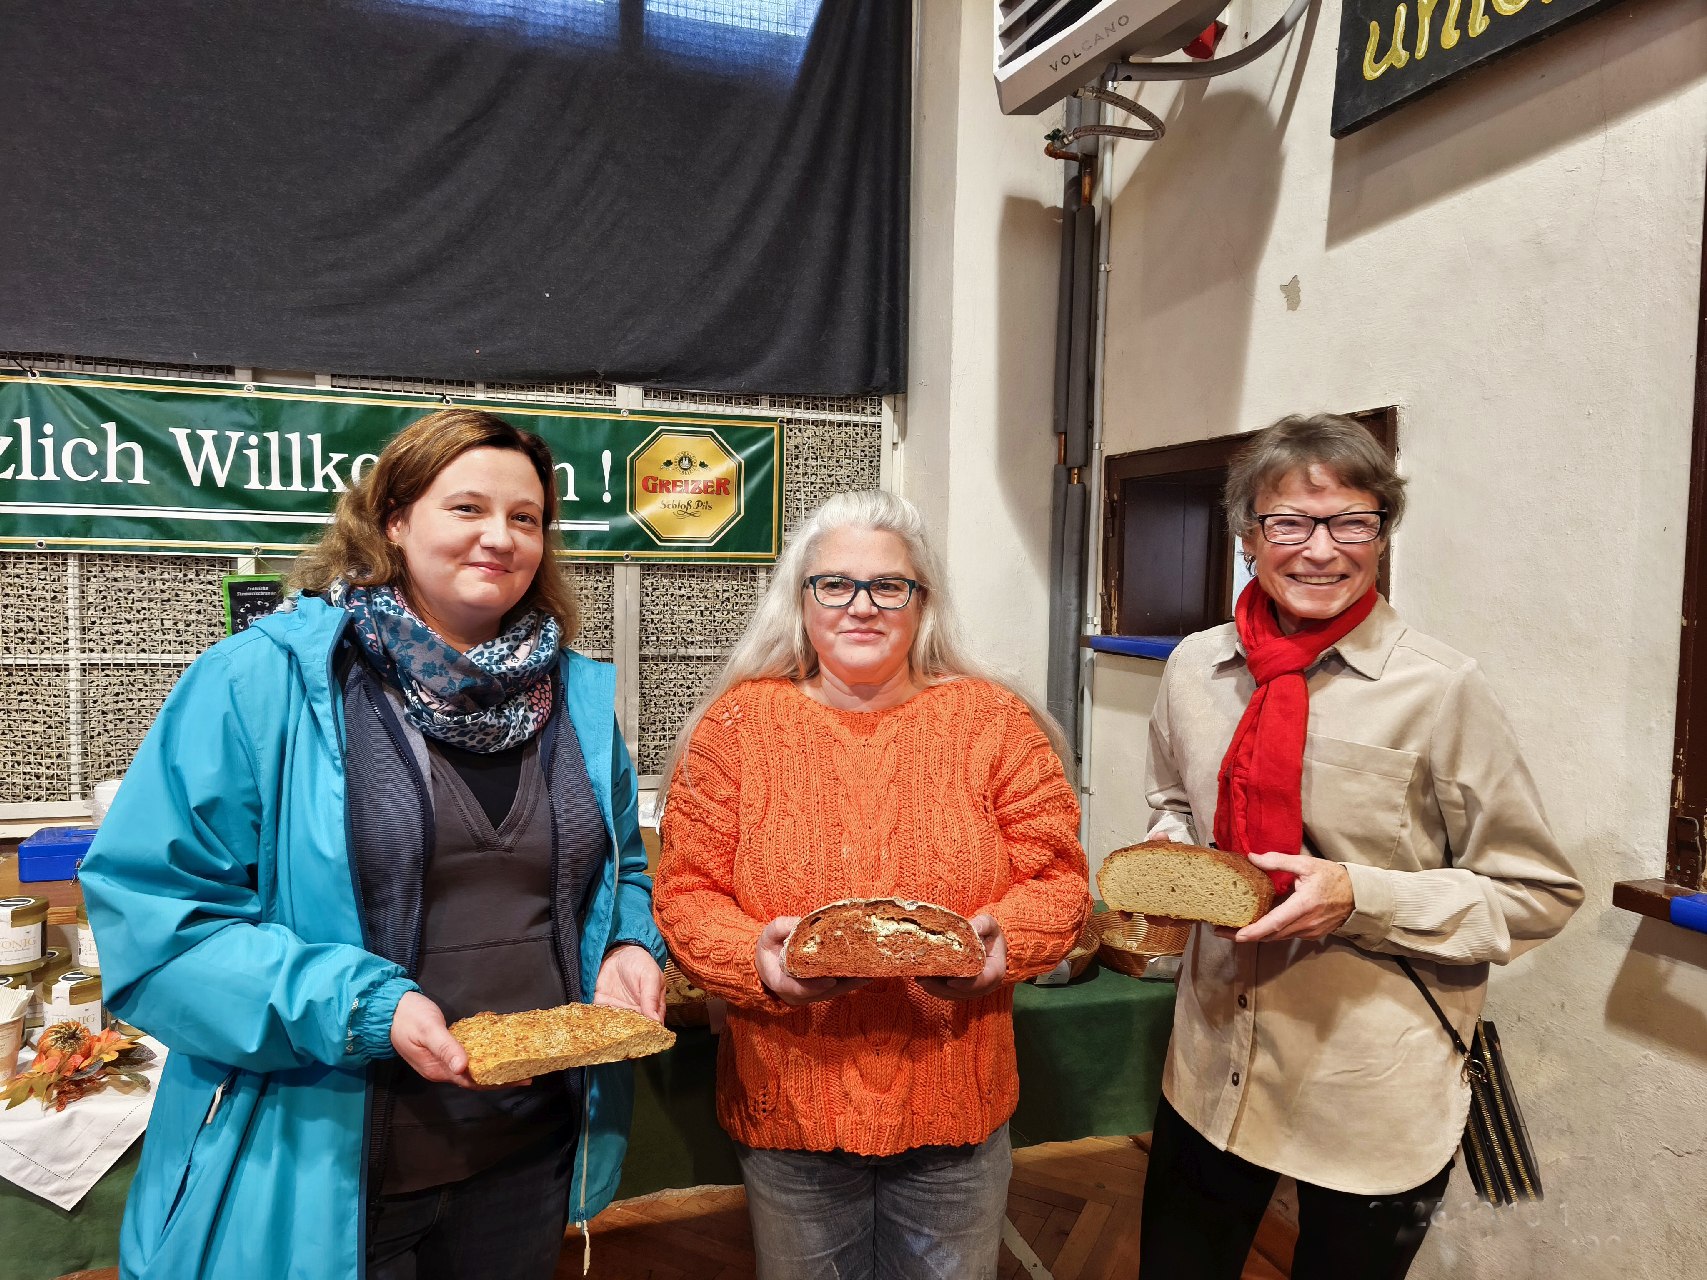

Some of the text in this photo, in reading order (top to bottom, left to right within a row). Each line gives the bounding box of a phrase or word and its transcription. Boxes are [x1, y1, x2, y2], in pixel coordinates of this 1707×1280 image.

[1049, 14, 1130, 73] VOLCANO
[601, 449, 613, 504] !
[641, 475, 731, 496] GREIZER
[660, 500, 713, 511] Schloß Pils
